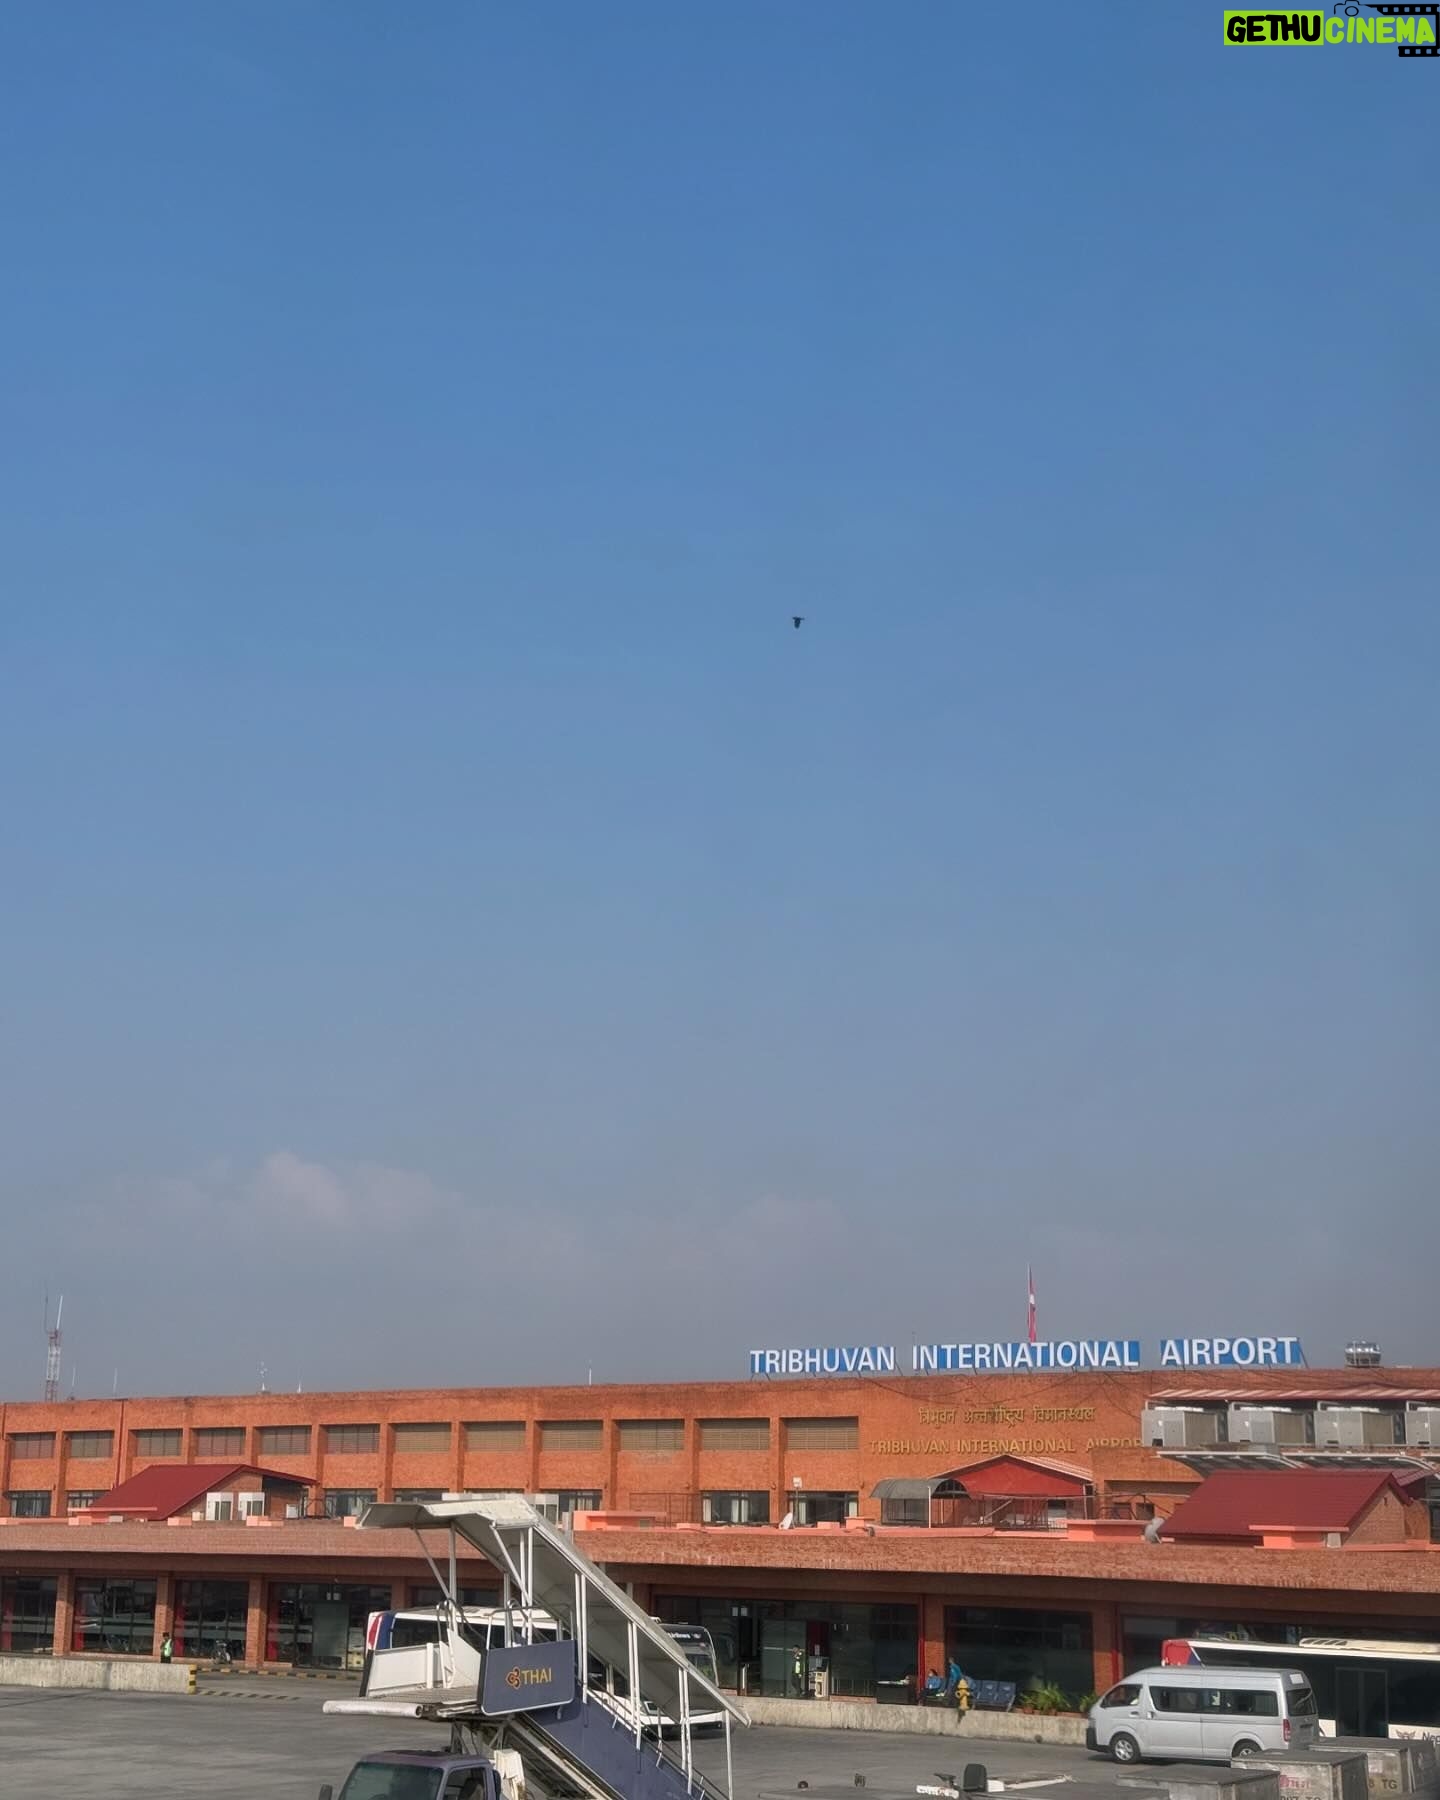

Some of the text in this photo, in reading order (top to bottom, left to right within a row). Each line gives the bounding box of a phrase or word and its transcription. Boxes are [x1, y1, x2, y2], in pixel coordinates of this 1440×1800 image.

[750, 1336, 1298, 1374] TRIBHUVAN INTERNATIONAL AIRPORT
[870, 1437, 1144, 1455] TRIBHUVAN INTERNATIONAL AIRPOR
[521, 1667, 552, 1685] THAI
